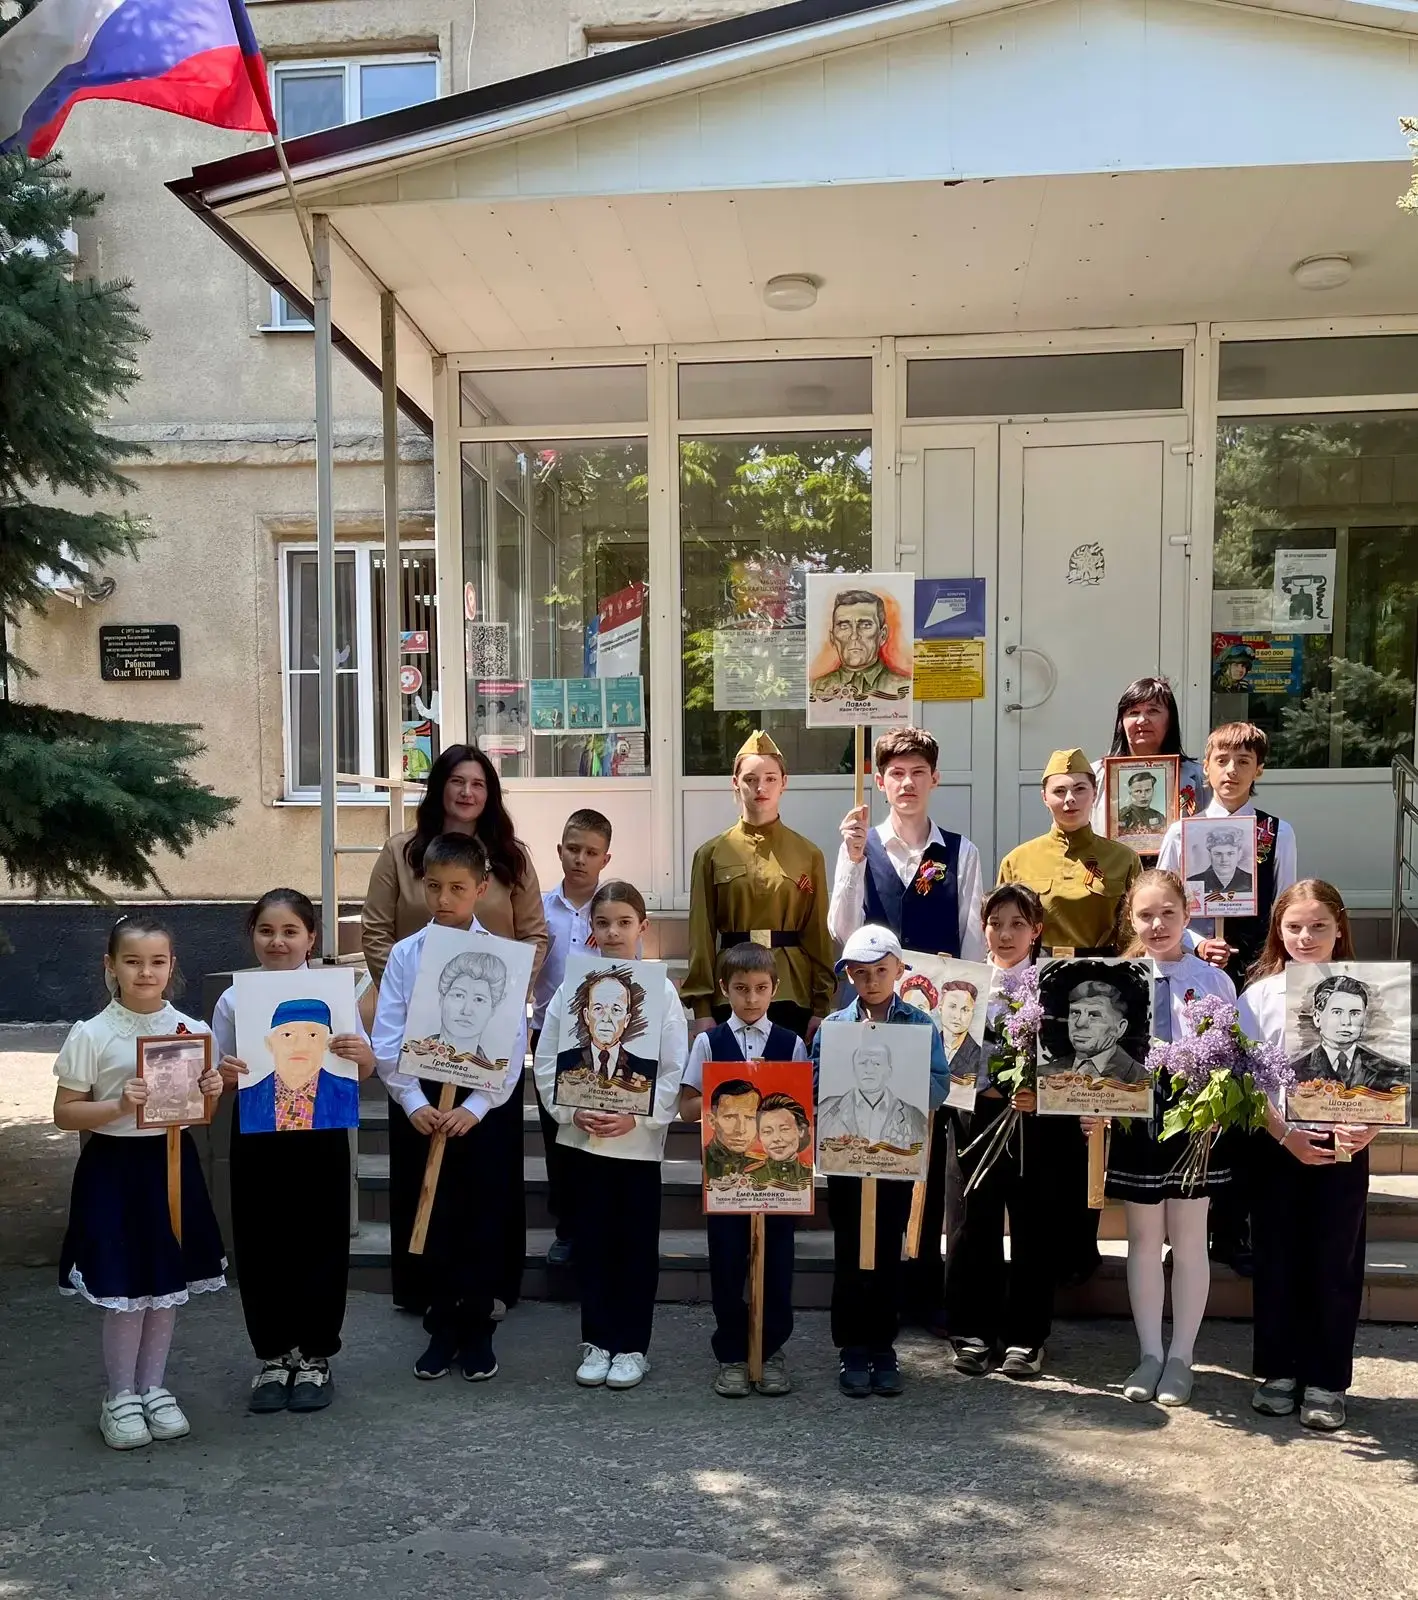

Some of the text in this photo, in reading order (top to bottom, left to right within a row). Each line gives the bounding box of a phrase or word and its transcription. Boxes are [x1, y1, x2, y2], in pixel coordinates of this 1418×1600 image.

[124, 659, 156, 668] Рябикин
[112, 667, 170, 679] Олег Петрович
[432, 1058, 469, 1072] Гребнева
[1070, 1090, 1116, 1098] Семизоров
[1328, 1100, 1363, 1108] Шахров
